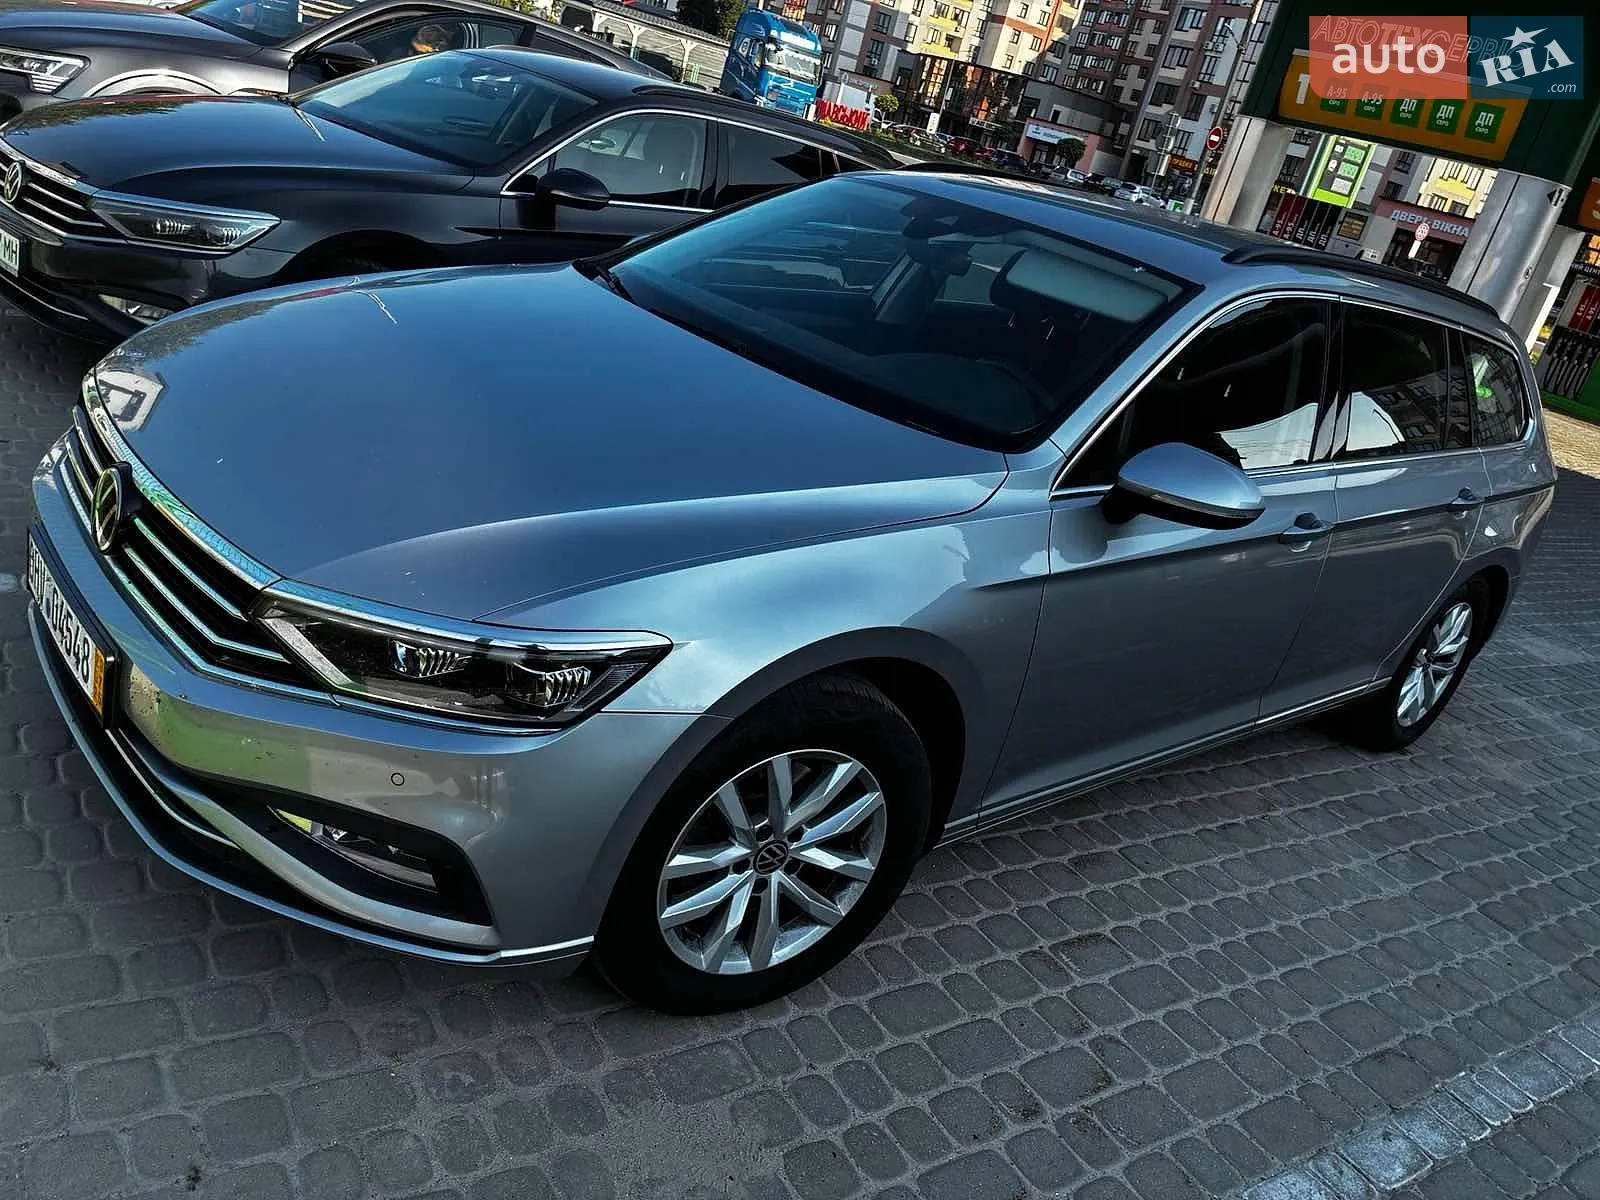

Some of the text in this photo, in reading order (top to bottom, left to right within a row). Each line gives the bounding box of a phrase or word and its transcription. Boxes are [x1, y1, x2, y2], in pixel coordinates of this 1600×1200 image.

[1296, 73, 1310, 104] 1
[1399, 98, 1418, 112] ДП
[1436, 105, 1455, 119] ДП
[1475, 112, 1495, 126] ДП
